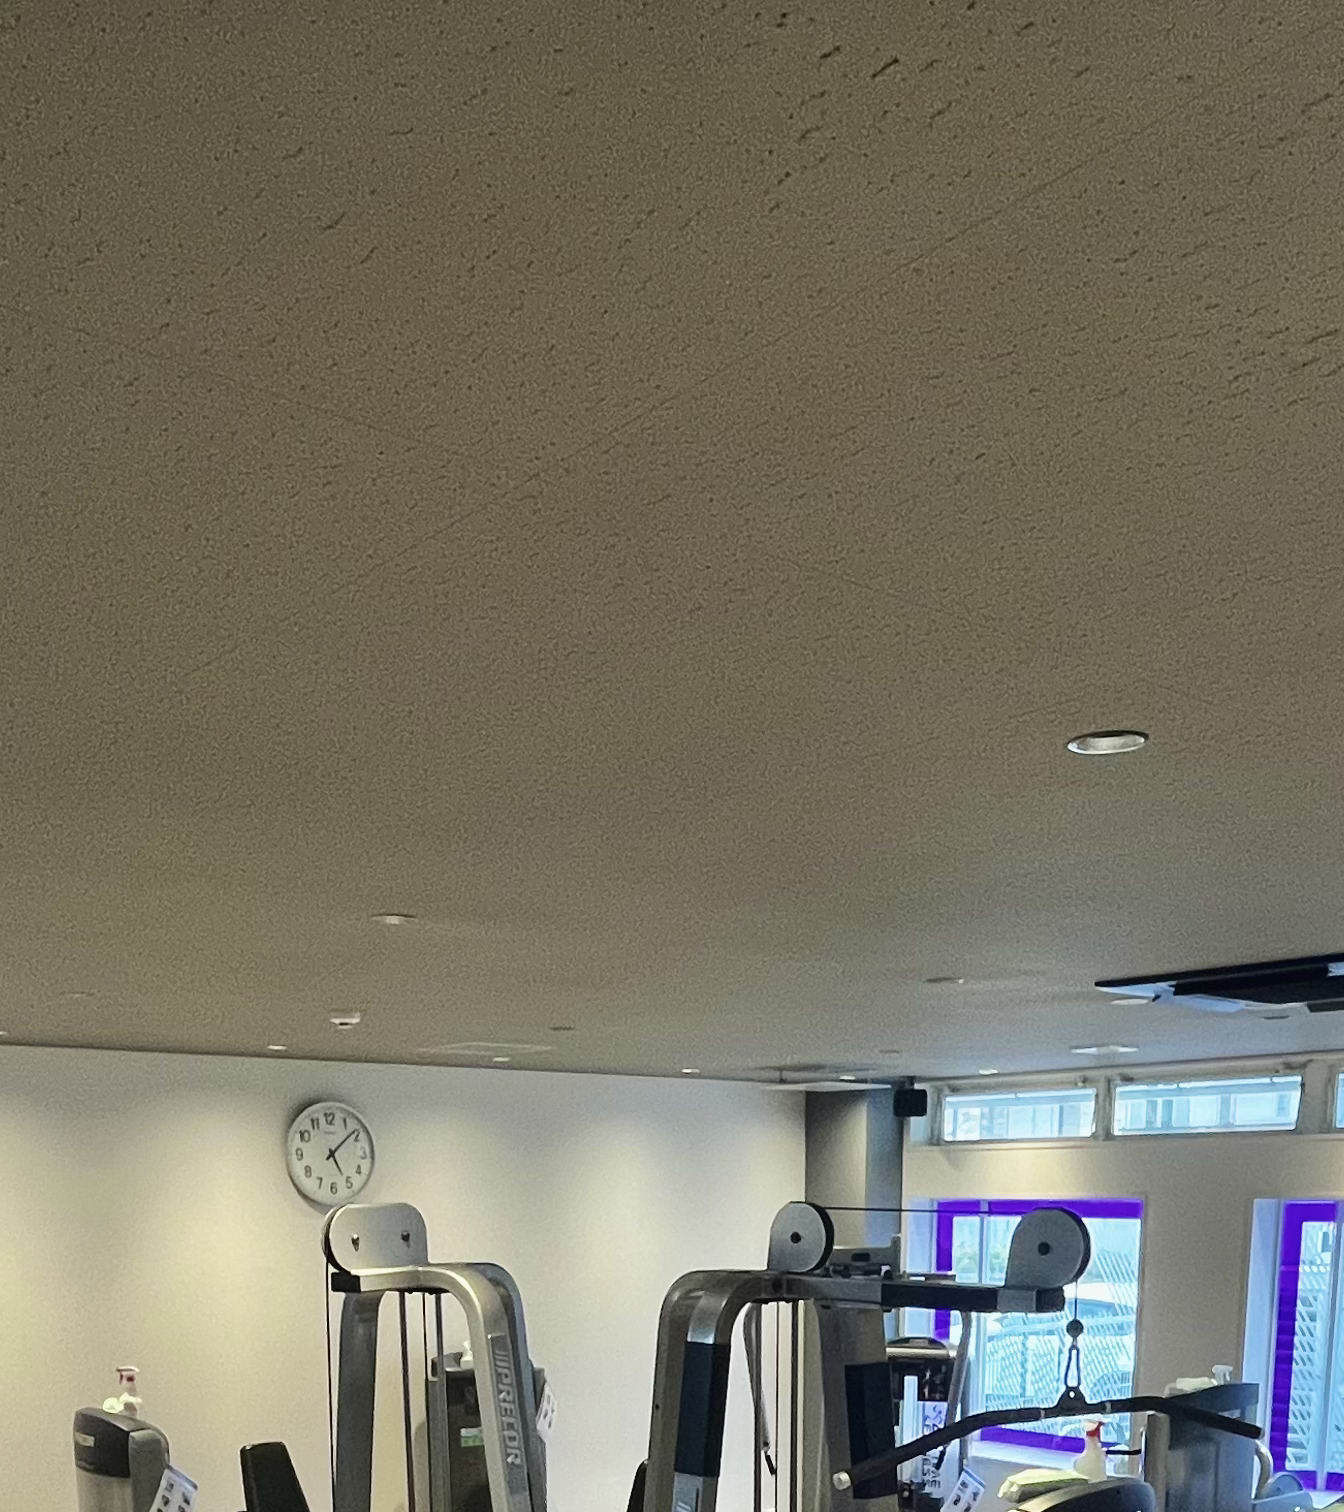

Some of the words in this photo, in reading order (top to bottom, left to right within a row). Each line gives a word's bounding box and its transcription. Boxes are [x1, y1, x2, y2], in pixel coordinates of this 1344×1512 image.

[310, 1117, 320, 1131] 11
[323, 1111, 336, 1126] 12
[342, 1117, 348, 1130] 1
[299, 1129, 311, 1143] 10
[296, 1147, 304, 1161] 9
[359, 1146, 367, 1160] 3
[304, 1165, 312, 1178] 8
[355, 1164, 362, 1176] 4
[316, 1177, 323, 1190] 7
[330, 1182, 338, 1195] 6
[345, 1176, 353, 1189] 5
[497, 1365, 523, 1466] PRECOR
